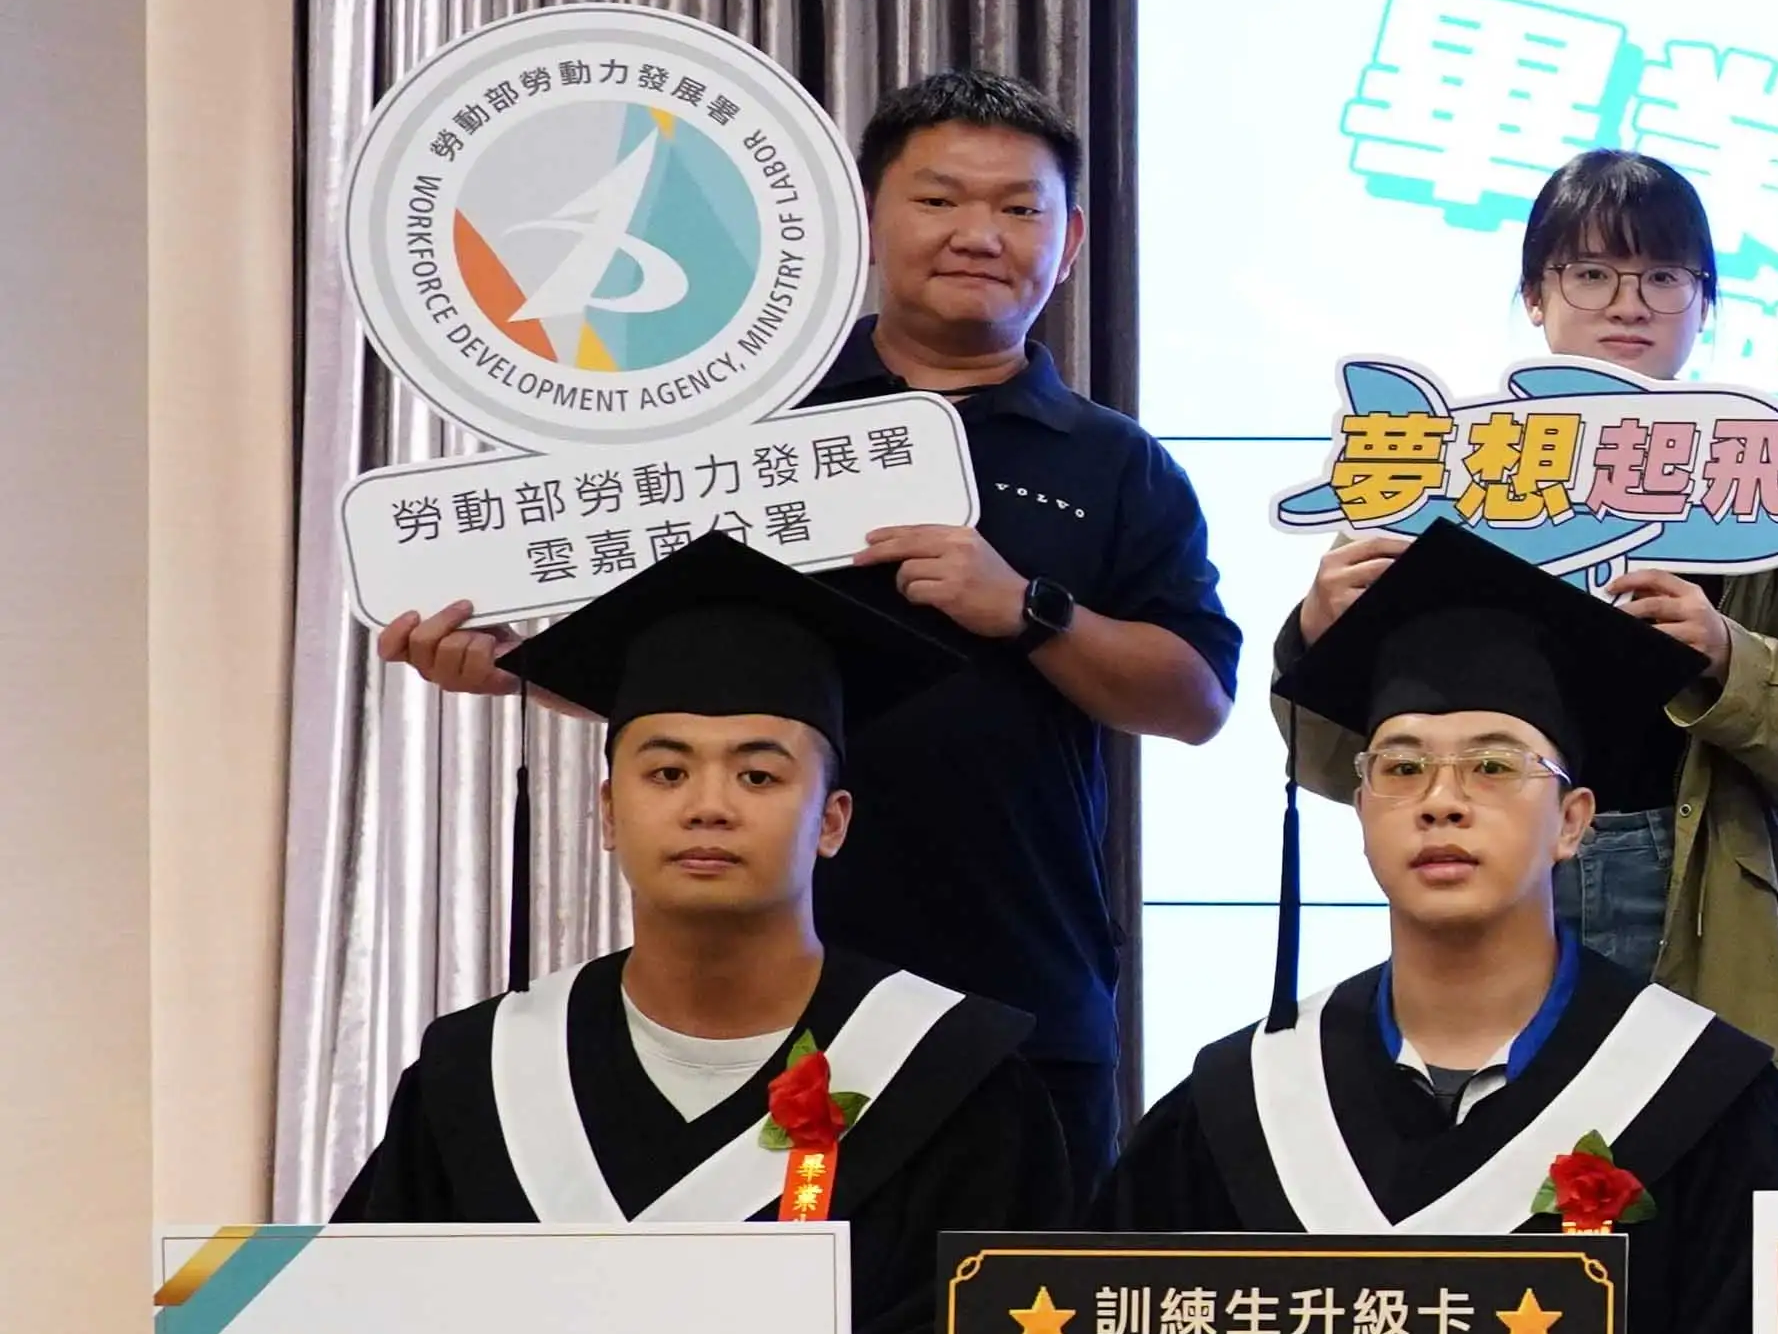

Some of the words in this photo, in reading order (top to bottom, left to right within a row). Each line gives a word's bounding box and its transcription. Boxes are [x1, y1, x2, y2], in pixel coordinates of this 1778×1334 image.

[429, 59, 742, 163] 勞動部勞動力發展署
[743, 129, 799, 208] LABOR
[406, 175, 458, 325] WORKFORCE
[782, 212, 804, 241] OF
[739, 253, 804, 353] MINISTRY
[447, 323, 629, 412] DEVELOPMENT
[640, 352, 746, 410] AGENCY,
[393, 424, 914, 545] 勞動部勞動力發展署
[995, 482, 1085, 518] VOLVO
[793, 1152, 828, 1223] 畢業
